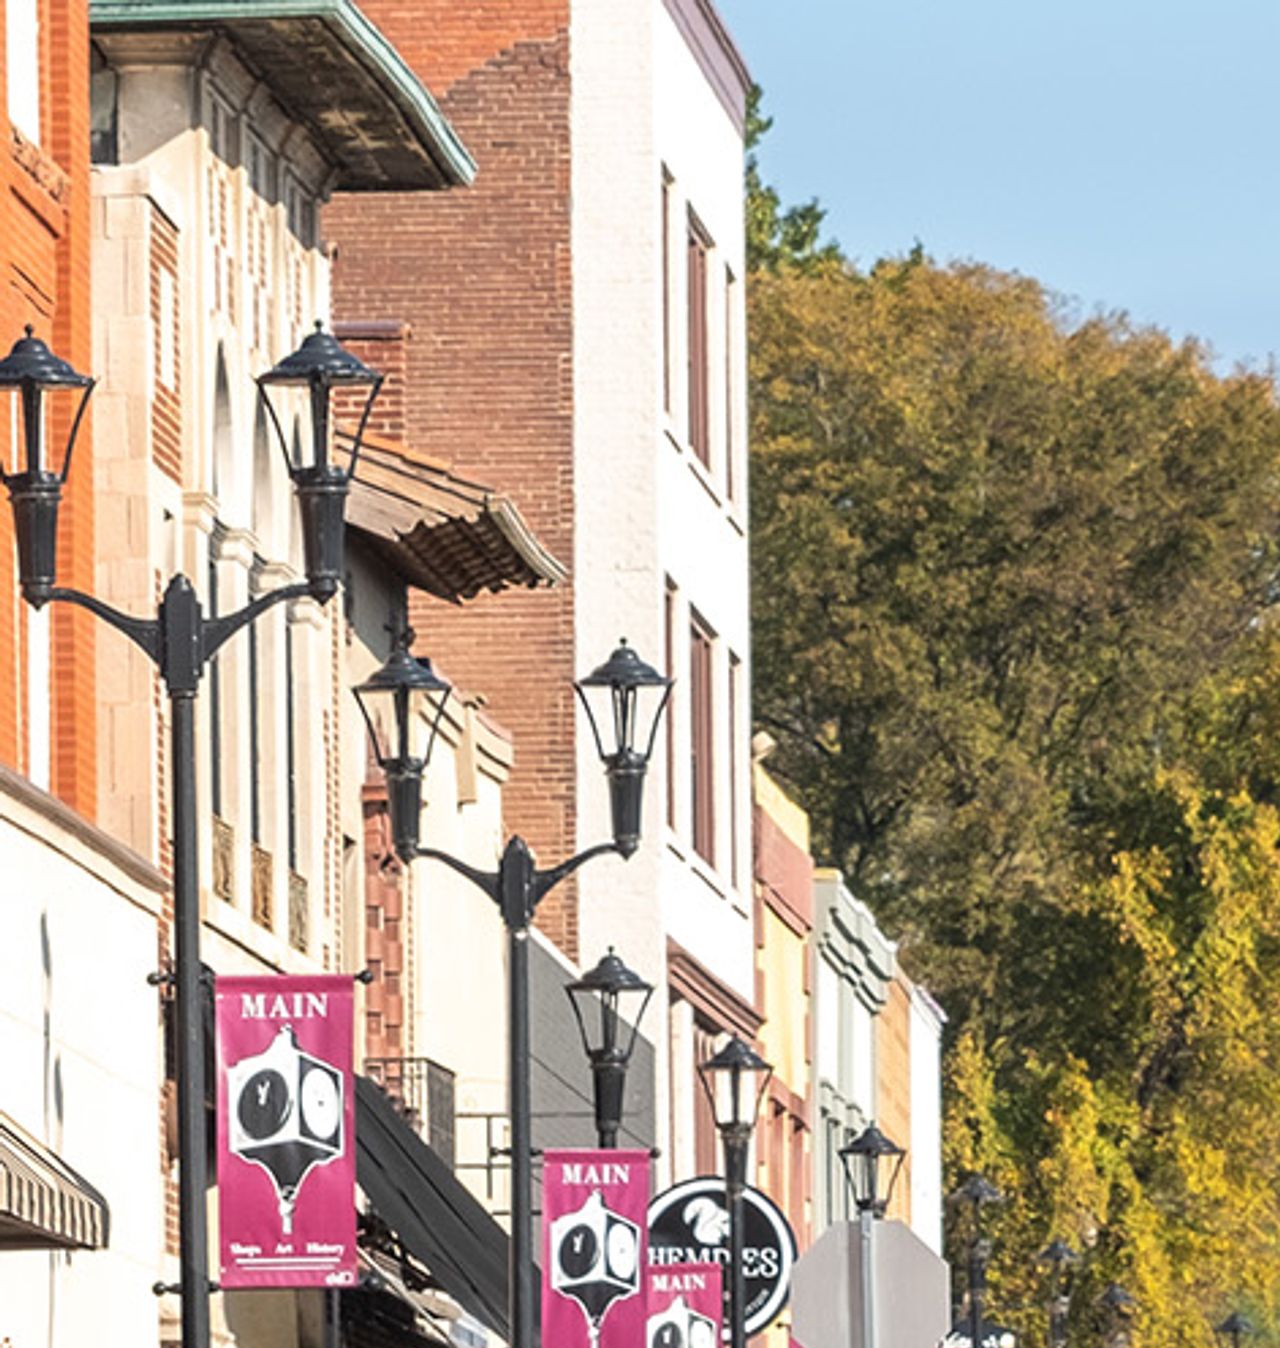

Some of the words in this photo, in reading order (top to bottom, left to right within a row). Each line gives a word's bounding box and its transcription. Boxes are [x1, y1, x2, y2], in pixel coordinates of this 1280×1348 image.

[241, 993, 328, 1018] MAIN
[562, 1163, 630, 1185] MAIN
[653, 1274, 706, 1292] MAIN
